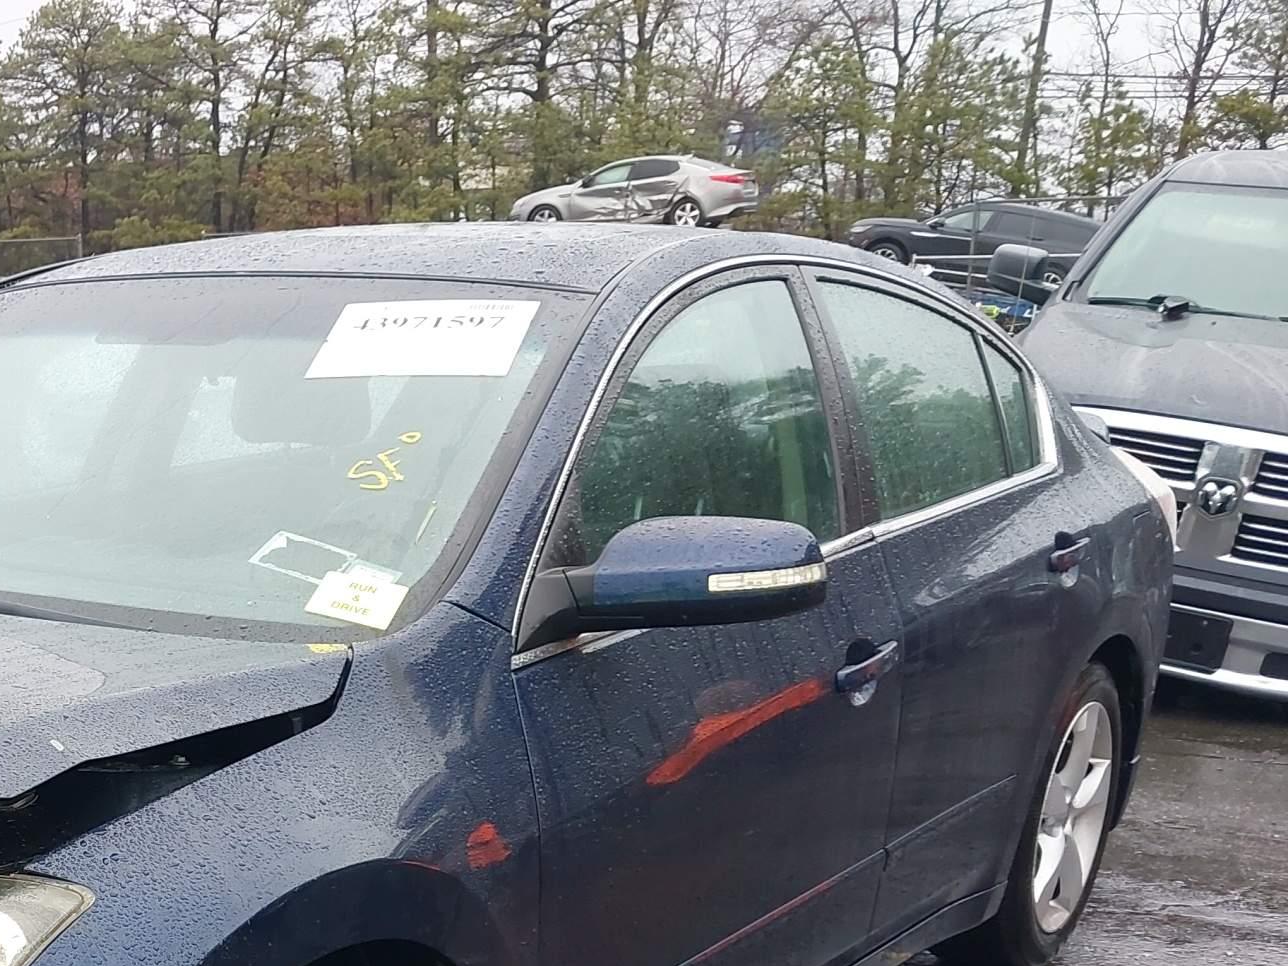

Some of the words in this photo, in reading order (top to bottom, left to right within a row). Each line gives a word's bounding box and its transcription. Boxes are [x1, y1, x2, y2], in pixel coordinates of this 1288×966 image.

[352, 315, 506, 331] 43971597
[348, 582, 378, 594] RUN
[352, 594, 361, 602] &
[330, 600, 370, 616] DRIVE
